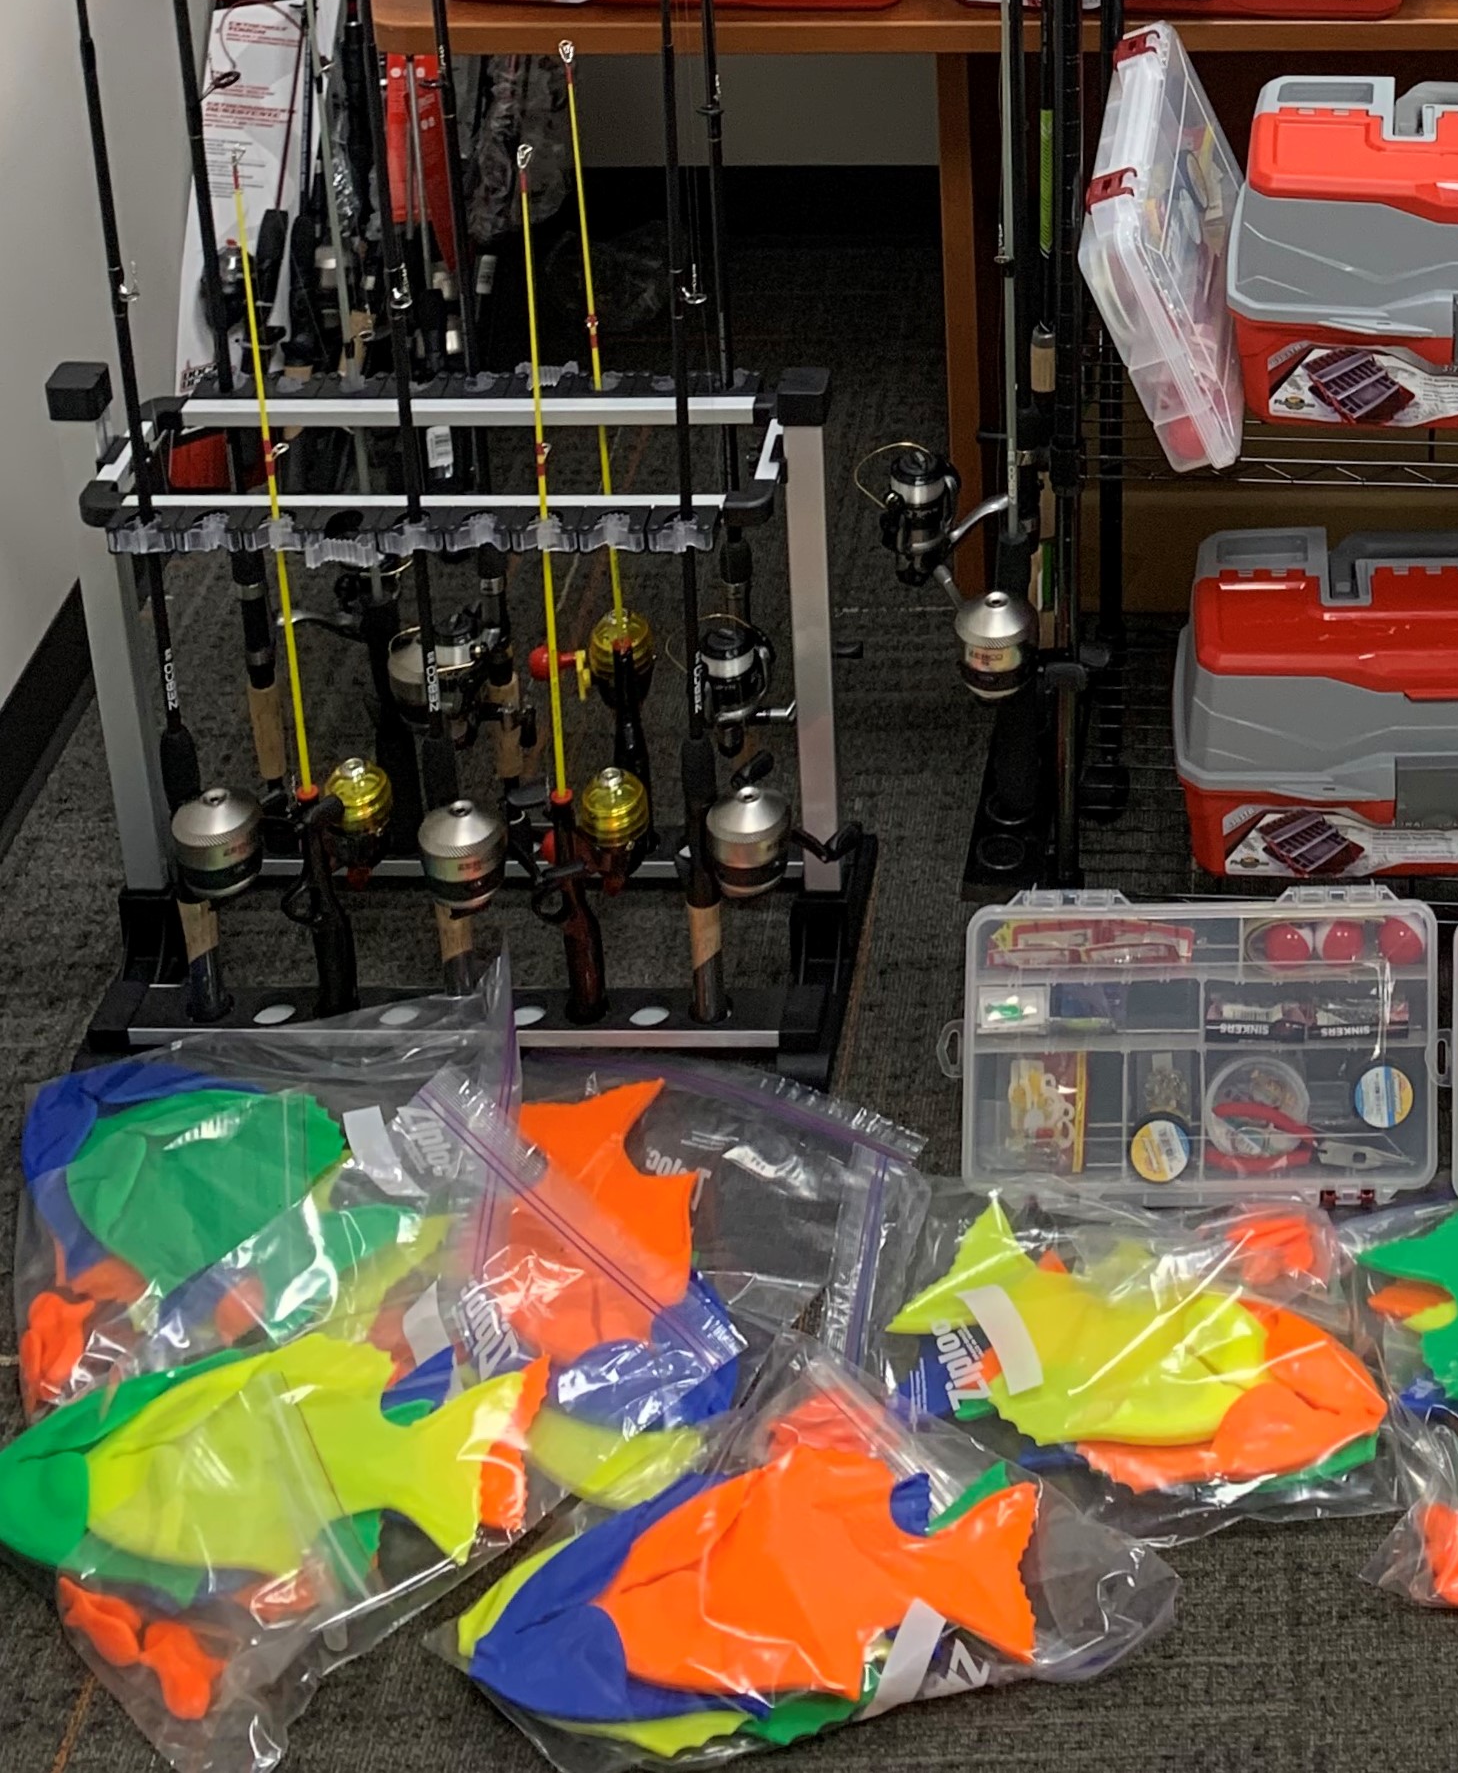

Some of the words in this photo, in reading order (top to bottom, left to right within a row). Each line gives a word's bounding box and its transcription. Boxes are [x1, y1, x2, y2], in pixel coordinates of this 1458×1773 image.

[163, 663, 179, 712] ZEBCO
[426, 666, 440, 713] ZEBCO
[1220, 1023, 1270, 1036] SINKERS
[1320, 1025, 1370, 1038] SINKERS
[931, 1319, 993, 1411] Ziploc
